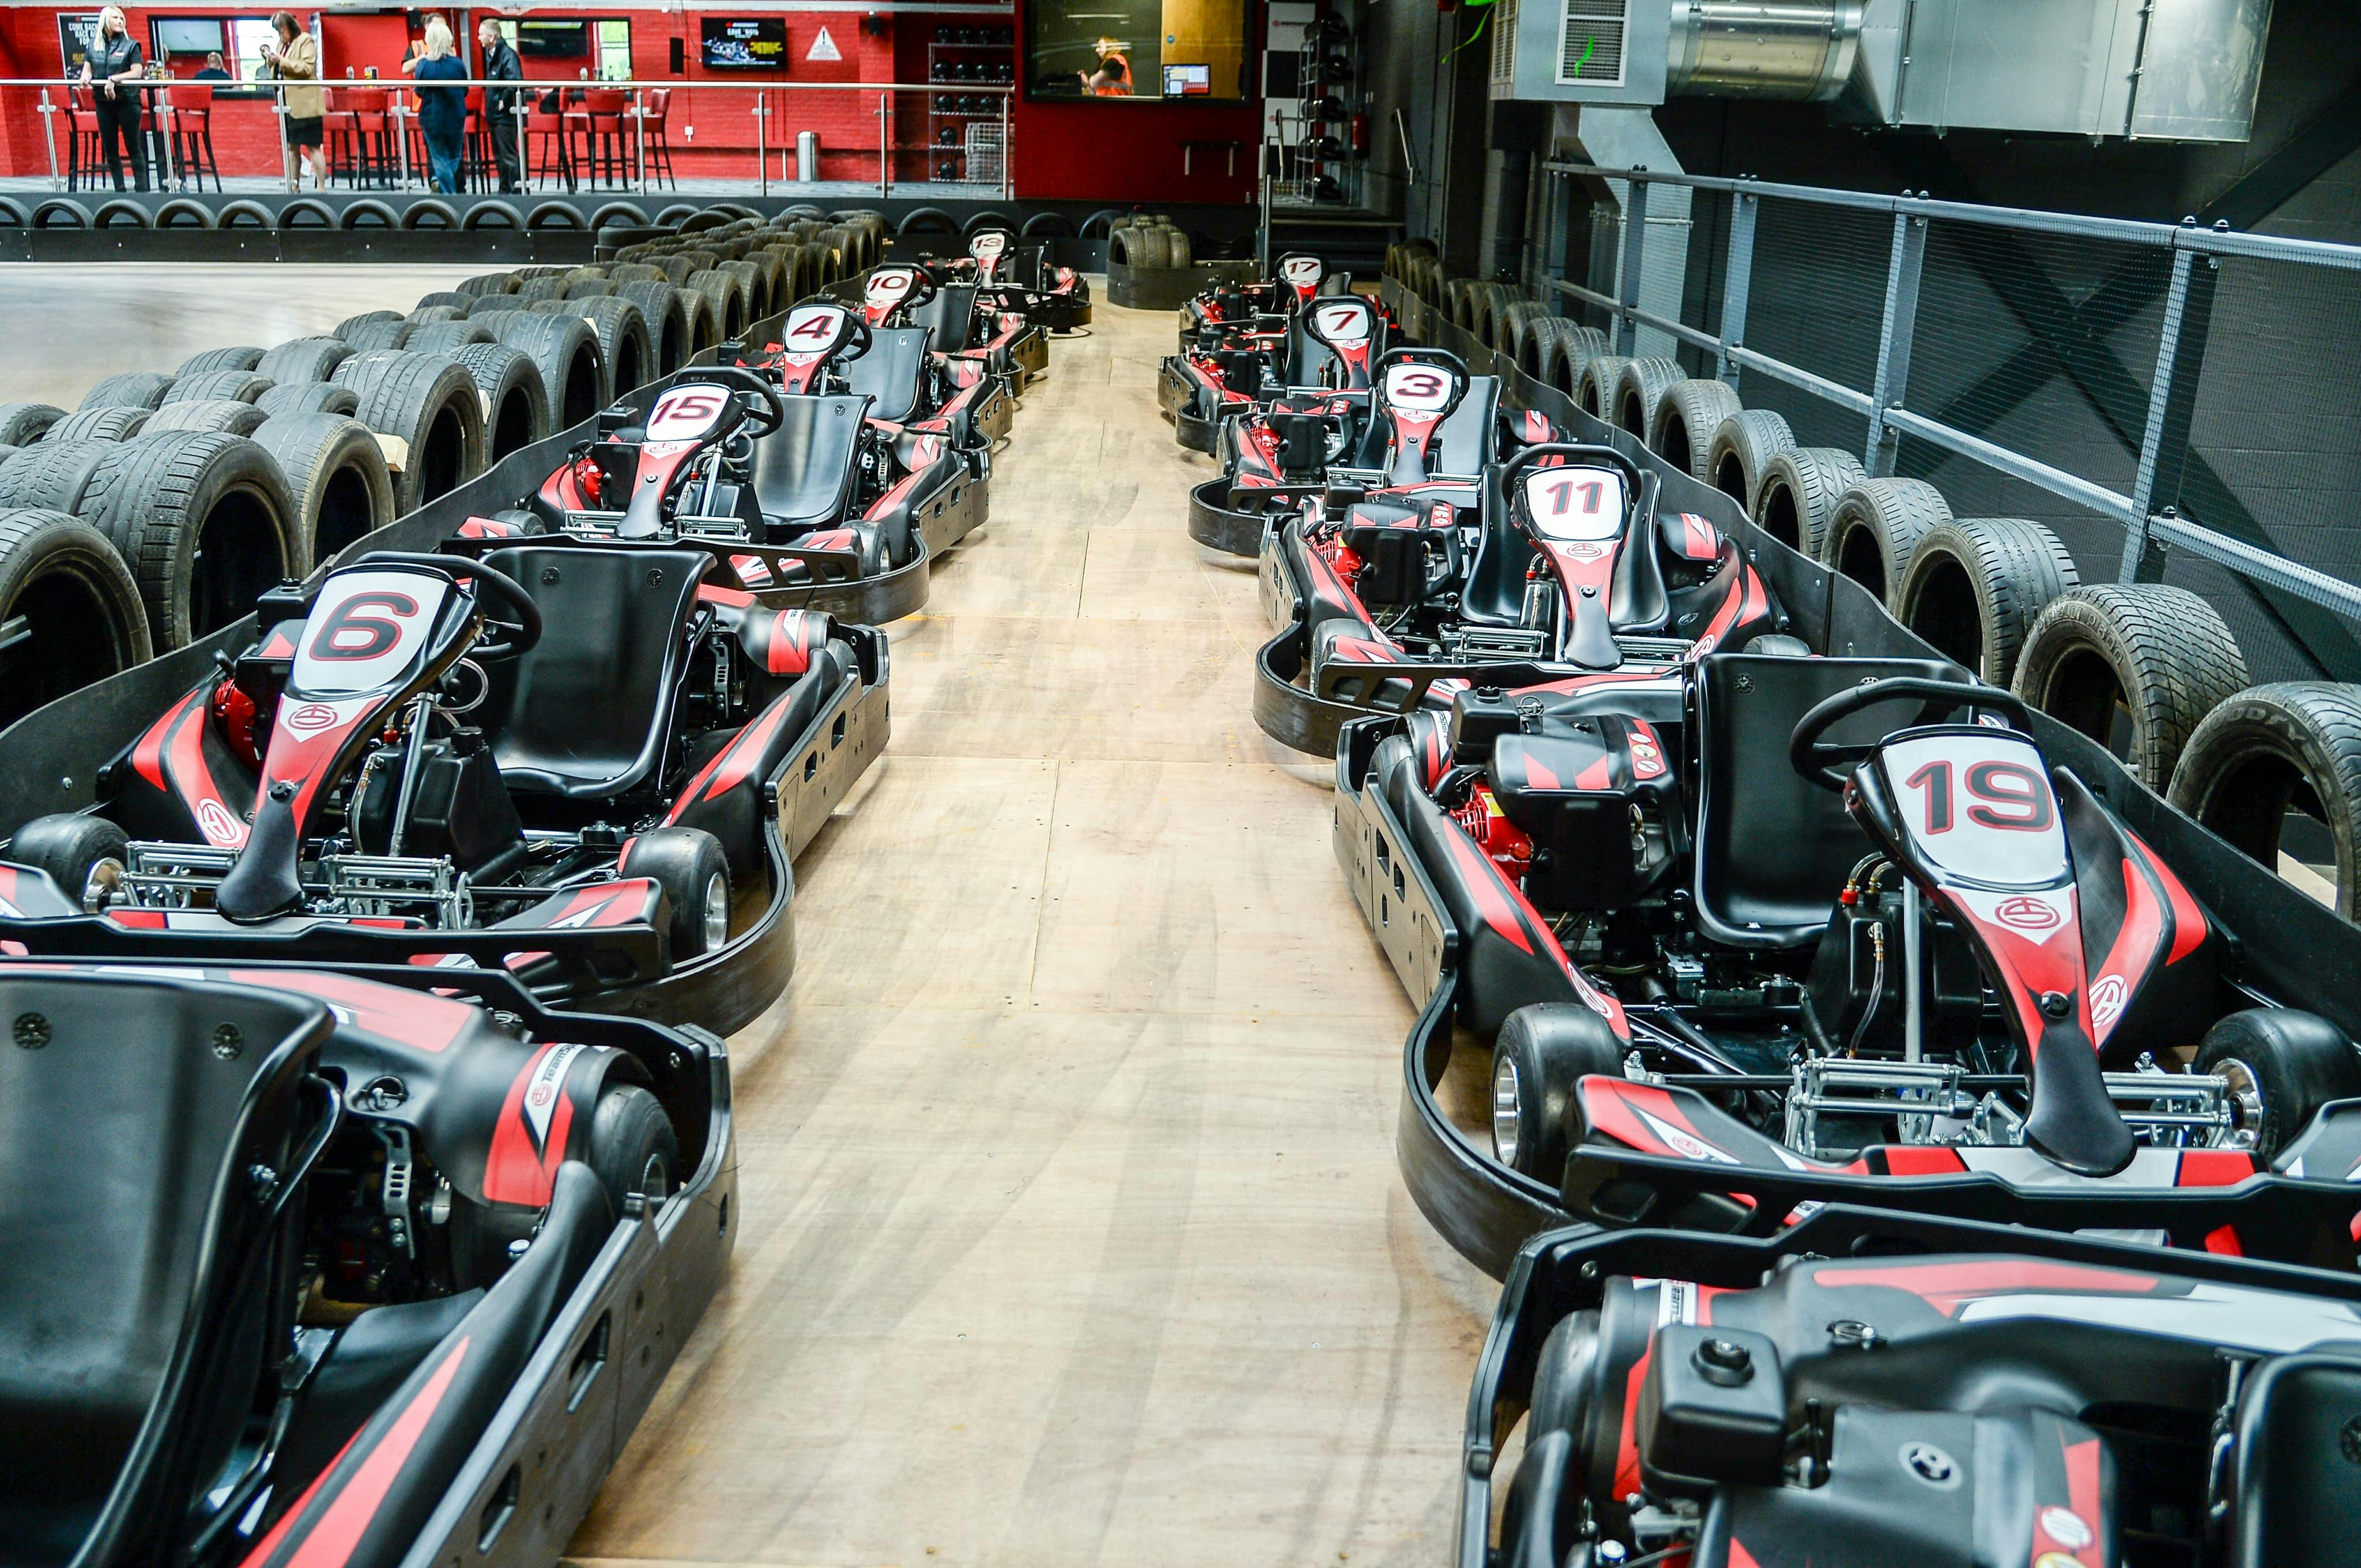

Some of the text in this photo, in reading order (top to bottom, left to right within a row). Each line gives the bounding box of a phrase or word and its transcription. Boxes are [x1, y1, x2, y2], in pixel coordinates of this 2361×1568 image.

[975, 238, 1002, 250] 13
[1288, 261, 1319, 274] 17
[869, 276, 908, 292] 10
[791, 315, 834, 339] 4
[1328, 310, 1359, 331] 7
[1396, 374, 1443, 397] 3
[651, 396, 722, 427] 15
[1547, 480, 1602, 514] 11
[309, 591, 419, 661] 6
[1905, 760, 2054, 835] 19
